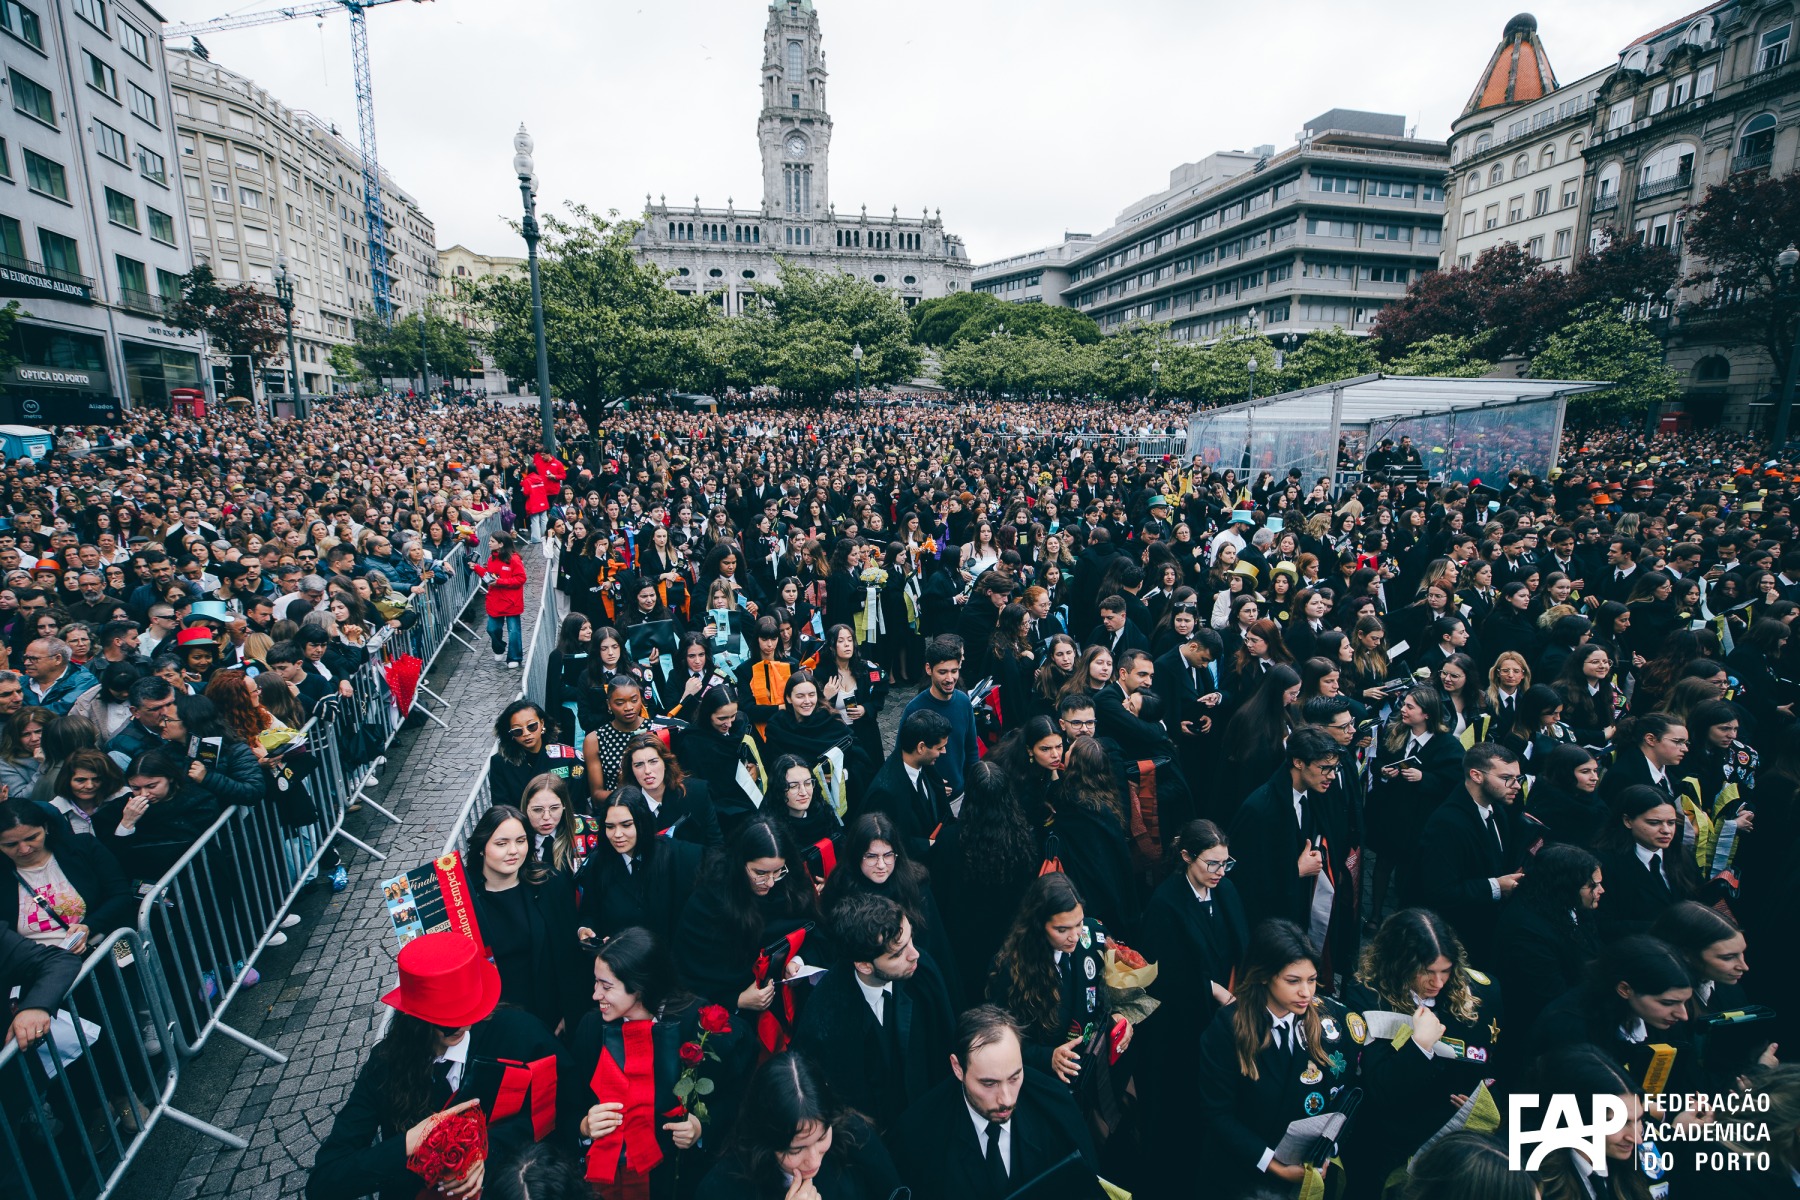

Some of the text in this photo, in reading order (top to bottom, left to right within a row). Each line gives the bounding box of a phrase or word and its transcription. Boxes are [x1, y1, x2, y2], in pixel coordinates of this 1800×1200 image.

[9, 270, 83, 296] EUROSTARS ALIADOS
[52, 372, 65, 382] DO
[65, 373, 89, 384] PORTO
[446, 871, 462, 907] semper
